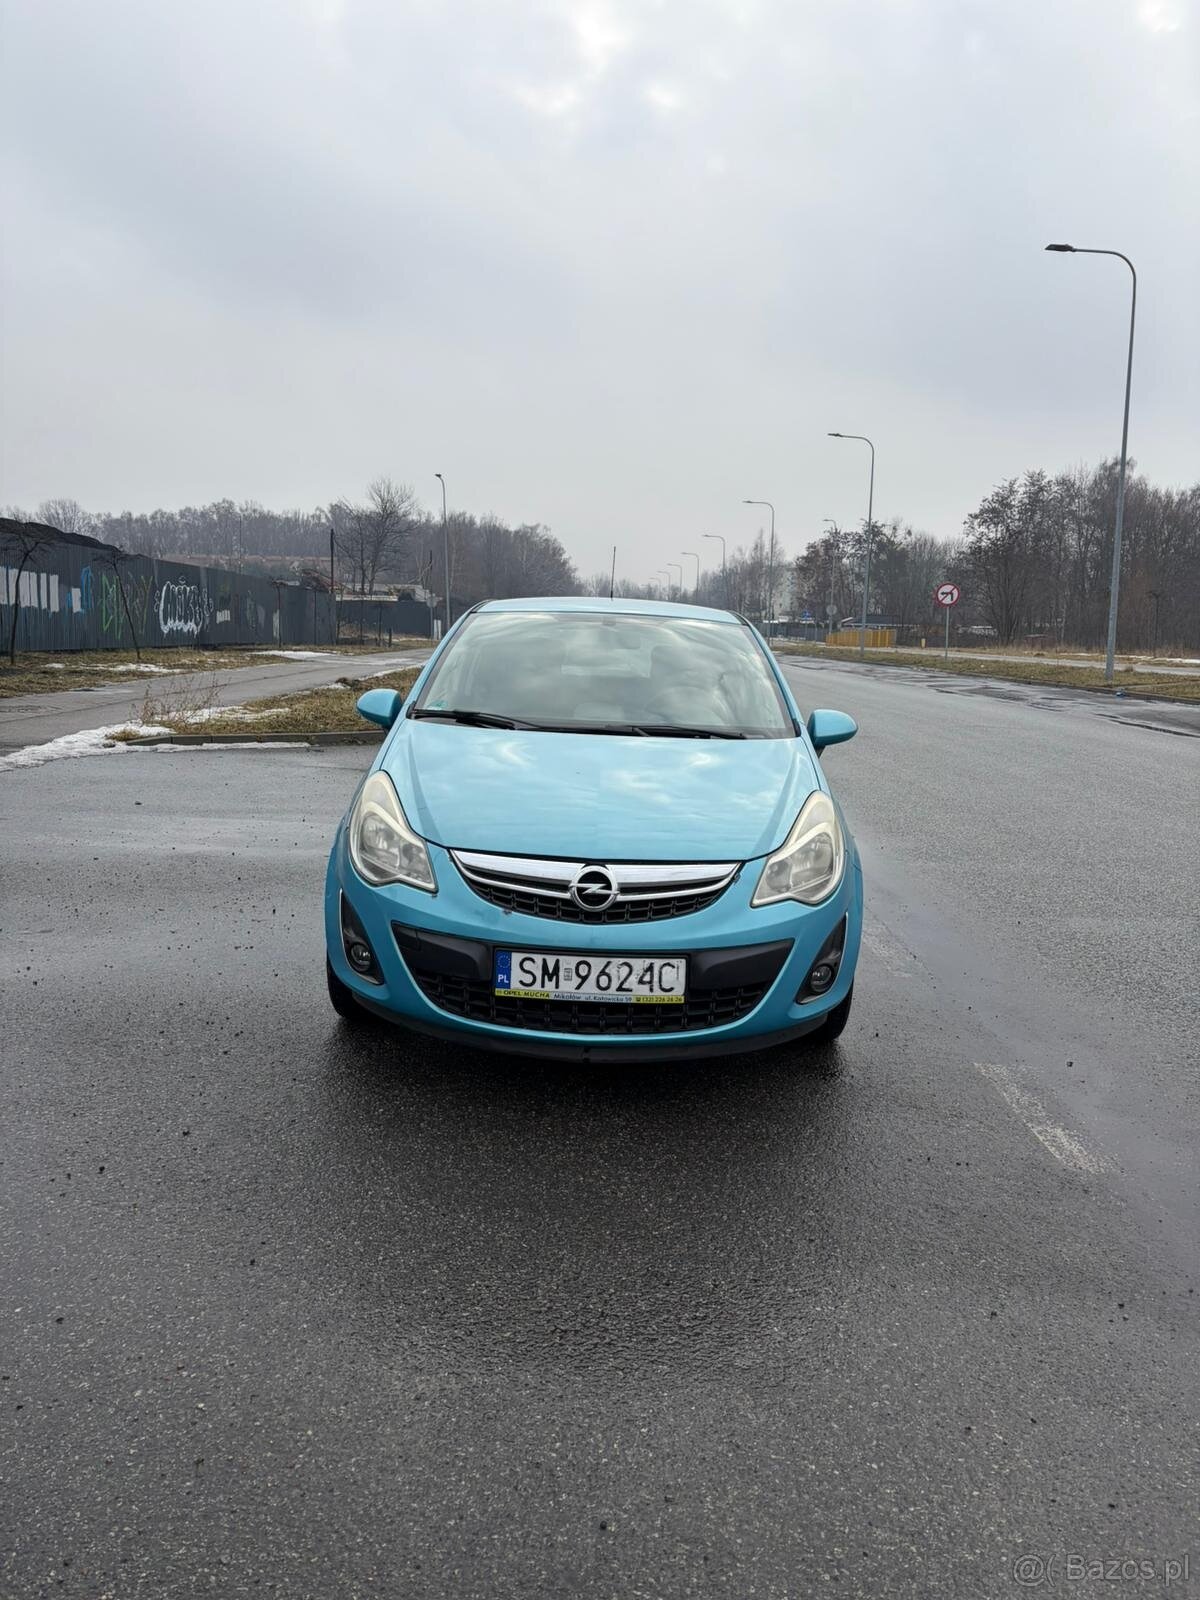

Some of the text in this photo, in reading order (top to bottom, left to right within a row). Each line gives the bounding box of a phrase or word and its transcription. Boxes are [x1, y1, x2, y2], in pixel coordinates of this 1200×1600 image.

[497, 974, 509, 983] PL
[519, 956, 676, 993] SM 9624C
